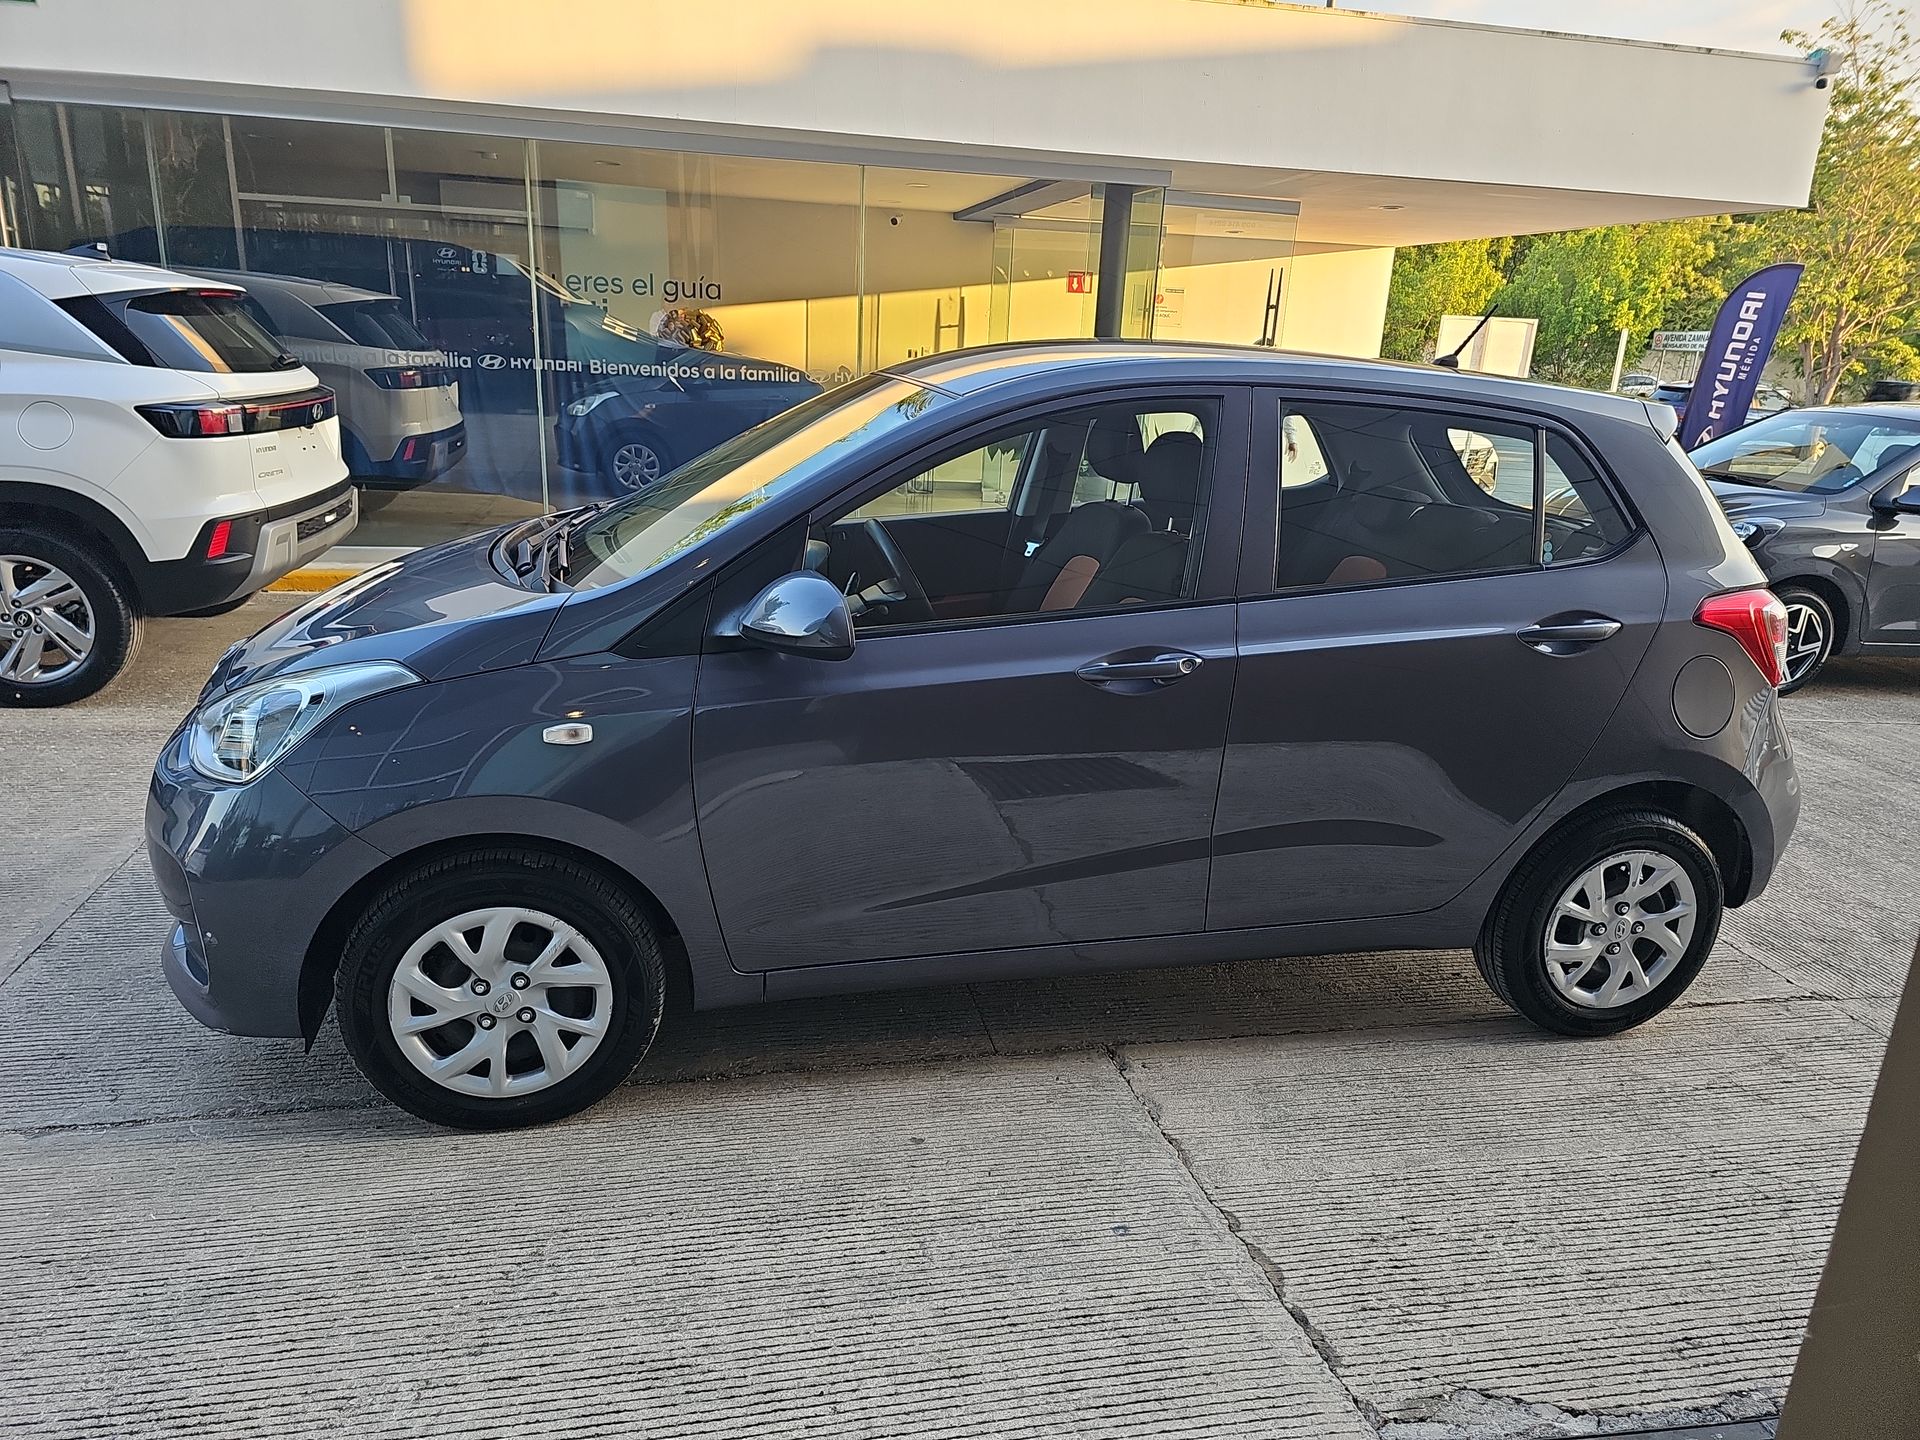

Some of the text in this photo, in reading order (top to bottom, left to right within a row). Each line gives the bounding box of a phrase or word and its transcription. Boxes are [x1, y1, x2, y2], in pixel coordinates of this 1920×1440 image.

[565, 273, 722, 303] eres el guía
[1664, 333, 1687, 342] AVENIDA
[1708, 291, 1767, 420] HYUNDAI
[1737, 337, 1762, 380] MÉRIDA
[589, 359, 700, 379] Bienvenidos
[703, 365, 716, 380] a
[719, 364, 736, 380] la
[740, 365, 800, 383] familia
